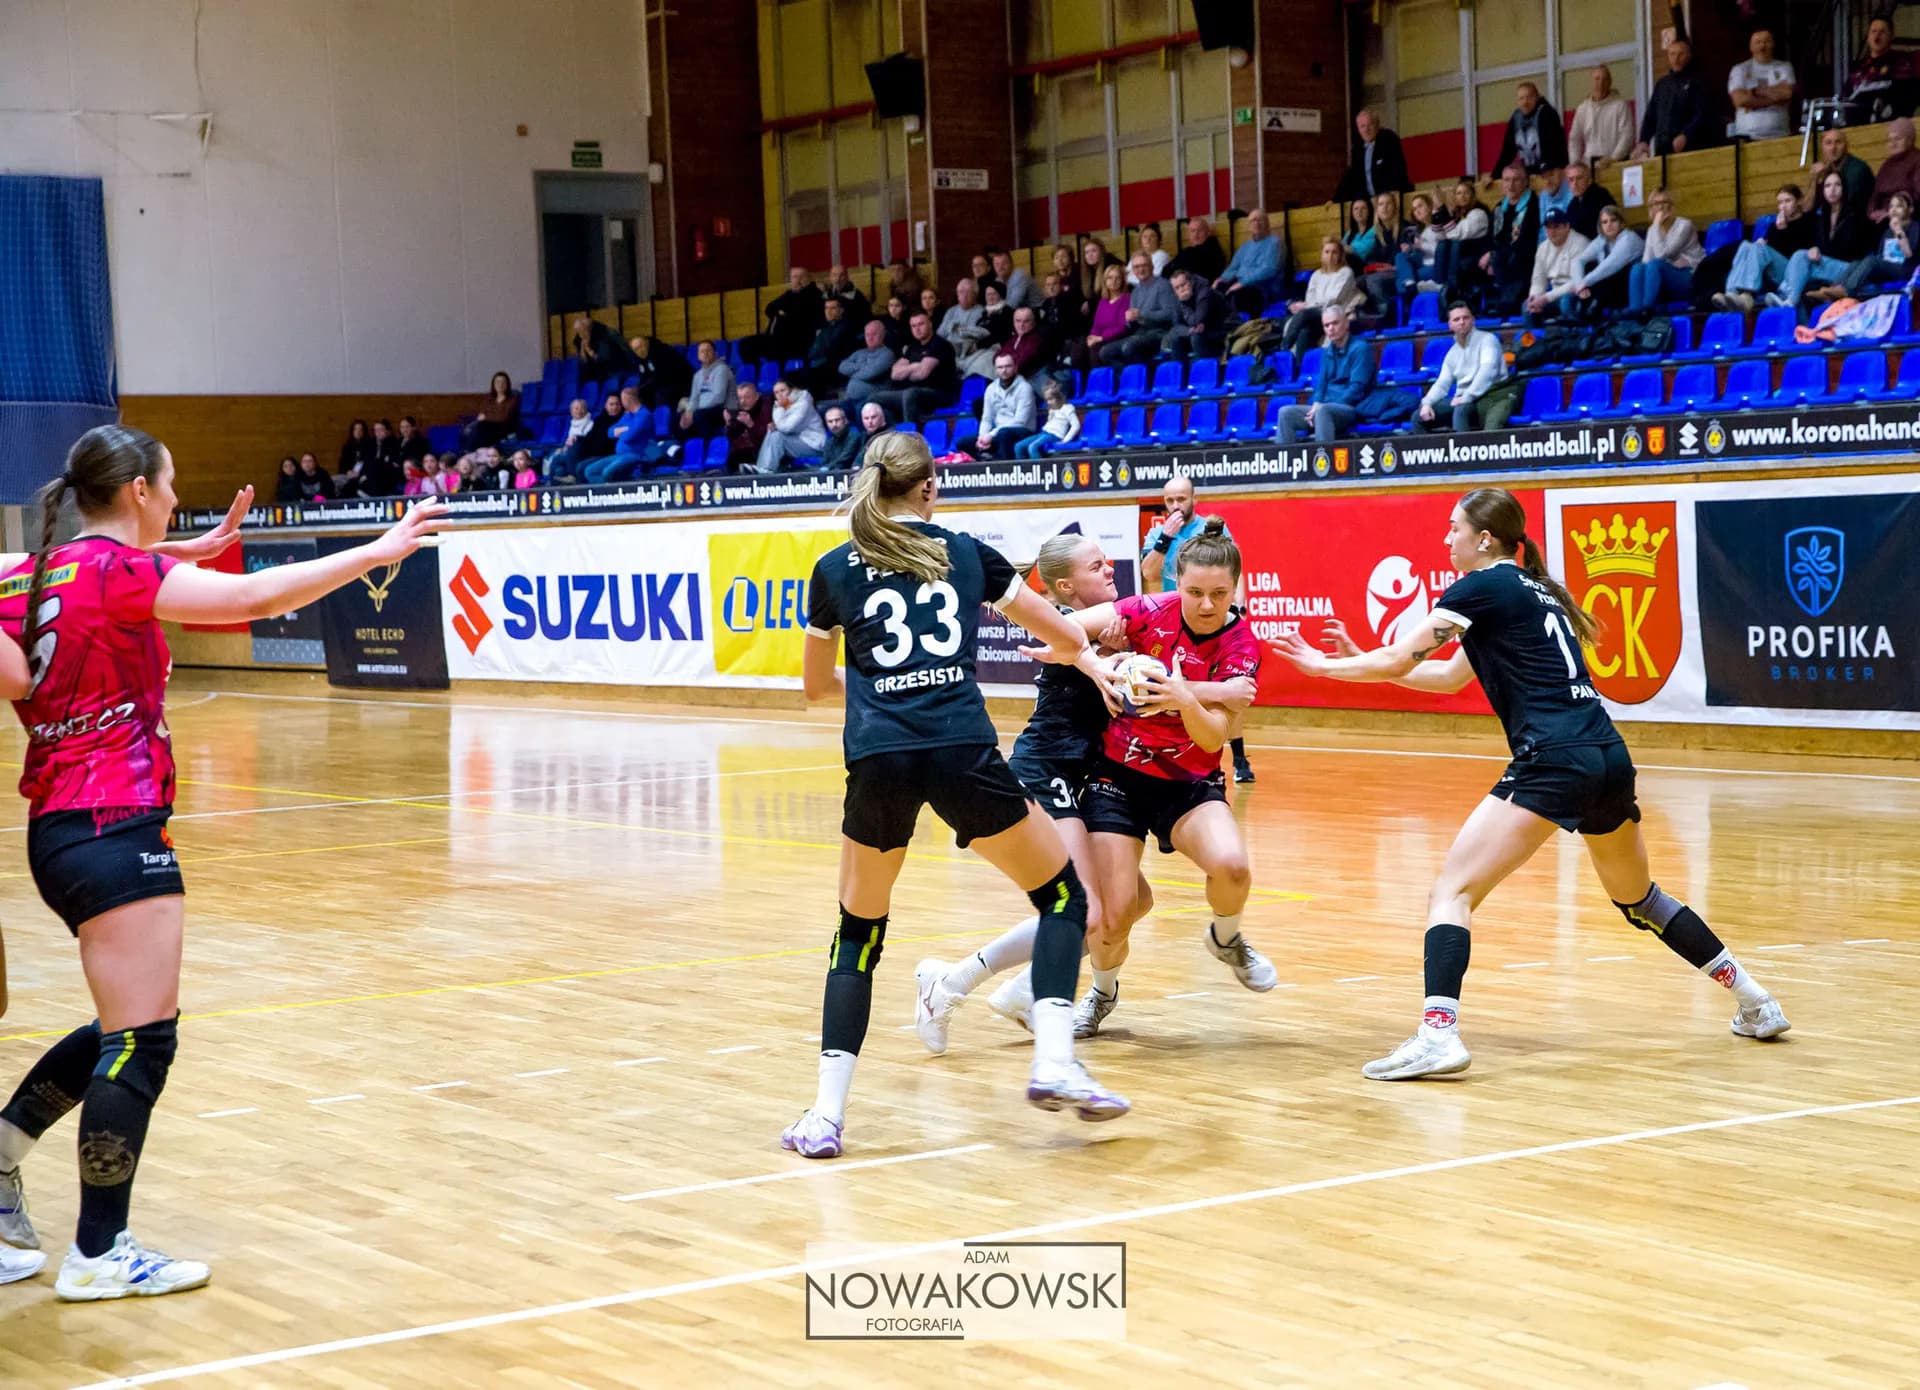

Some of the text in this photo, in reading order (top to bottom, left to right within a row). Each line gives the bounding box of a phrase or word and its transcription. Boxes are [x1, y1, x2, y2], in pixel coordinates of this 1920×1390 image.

[1402, 428, 1615, 465] www.koronahandball.pl
[1135, 450, 1308, 481] www.koronahandball.pl
[563, 484, 671, 508] www.koronahandball.pl
[725, 474, 849, 501] www.koronahandball.pl
[1248, 572, 1281, 592] LIGA
[503, 573, 703, 642] SUZUKI
[1249, 597, 1334, 617] CENTRALNA
[863, 580, 963, 667] 33
[1581, 583, 1661, 679] CK
[1748, 625, 1896, 658] PROFIKA
[874, 666, 965, 693] GRZESISTA
[1771, 664, 1875, 681] BROKER
[139, 851, 171, 866] Targi
